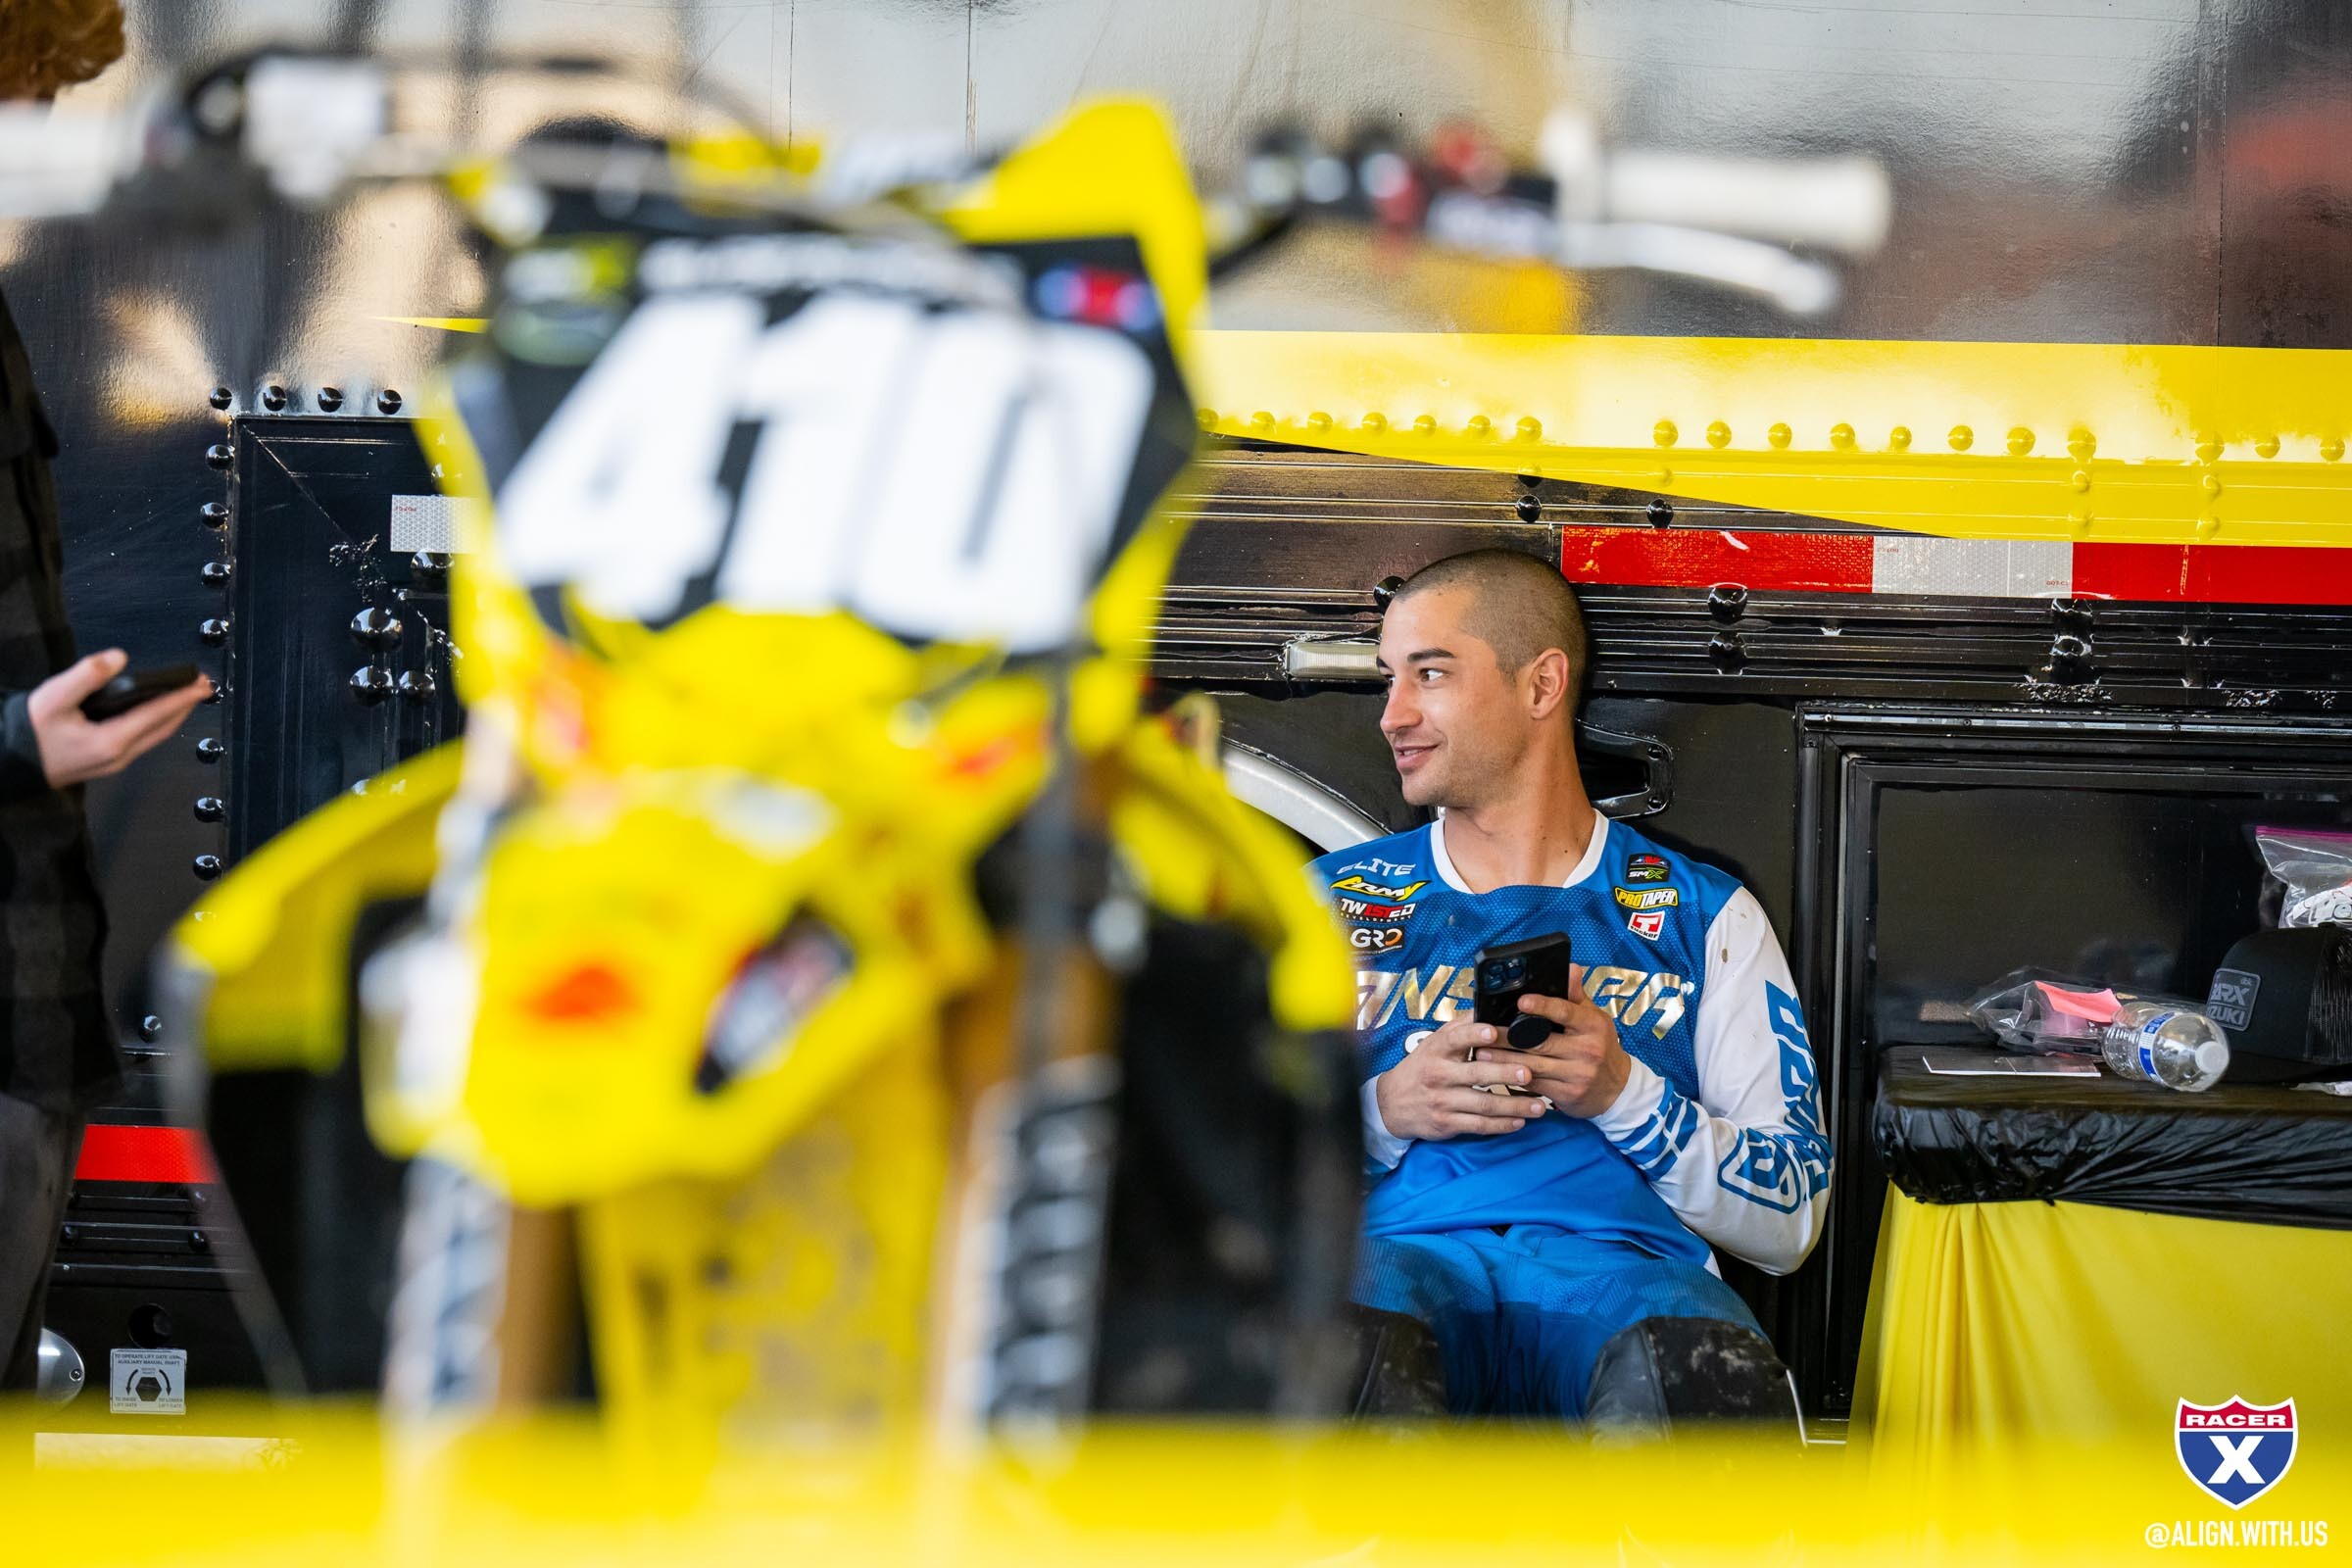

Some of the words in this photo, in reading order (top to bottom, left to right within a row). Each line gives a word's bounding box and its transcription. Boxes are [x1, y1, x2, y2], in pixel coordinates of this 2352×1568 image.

[497, 290, 1156, 653] 410
[1336, 858, 1416, 877] ELITE
[1341, 898, 1416, 918] TWISTED
[1349, 928, 1402, 948] GRO
[2210, 983, 2250, 1005] ARX
[2206, 1005, 2246, 1025] ZUKI
